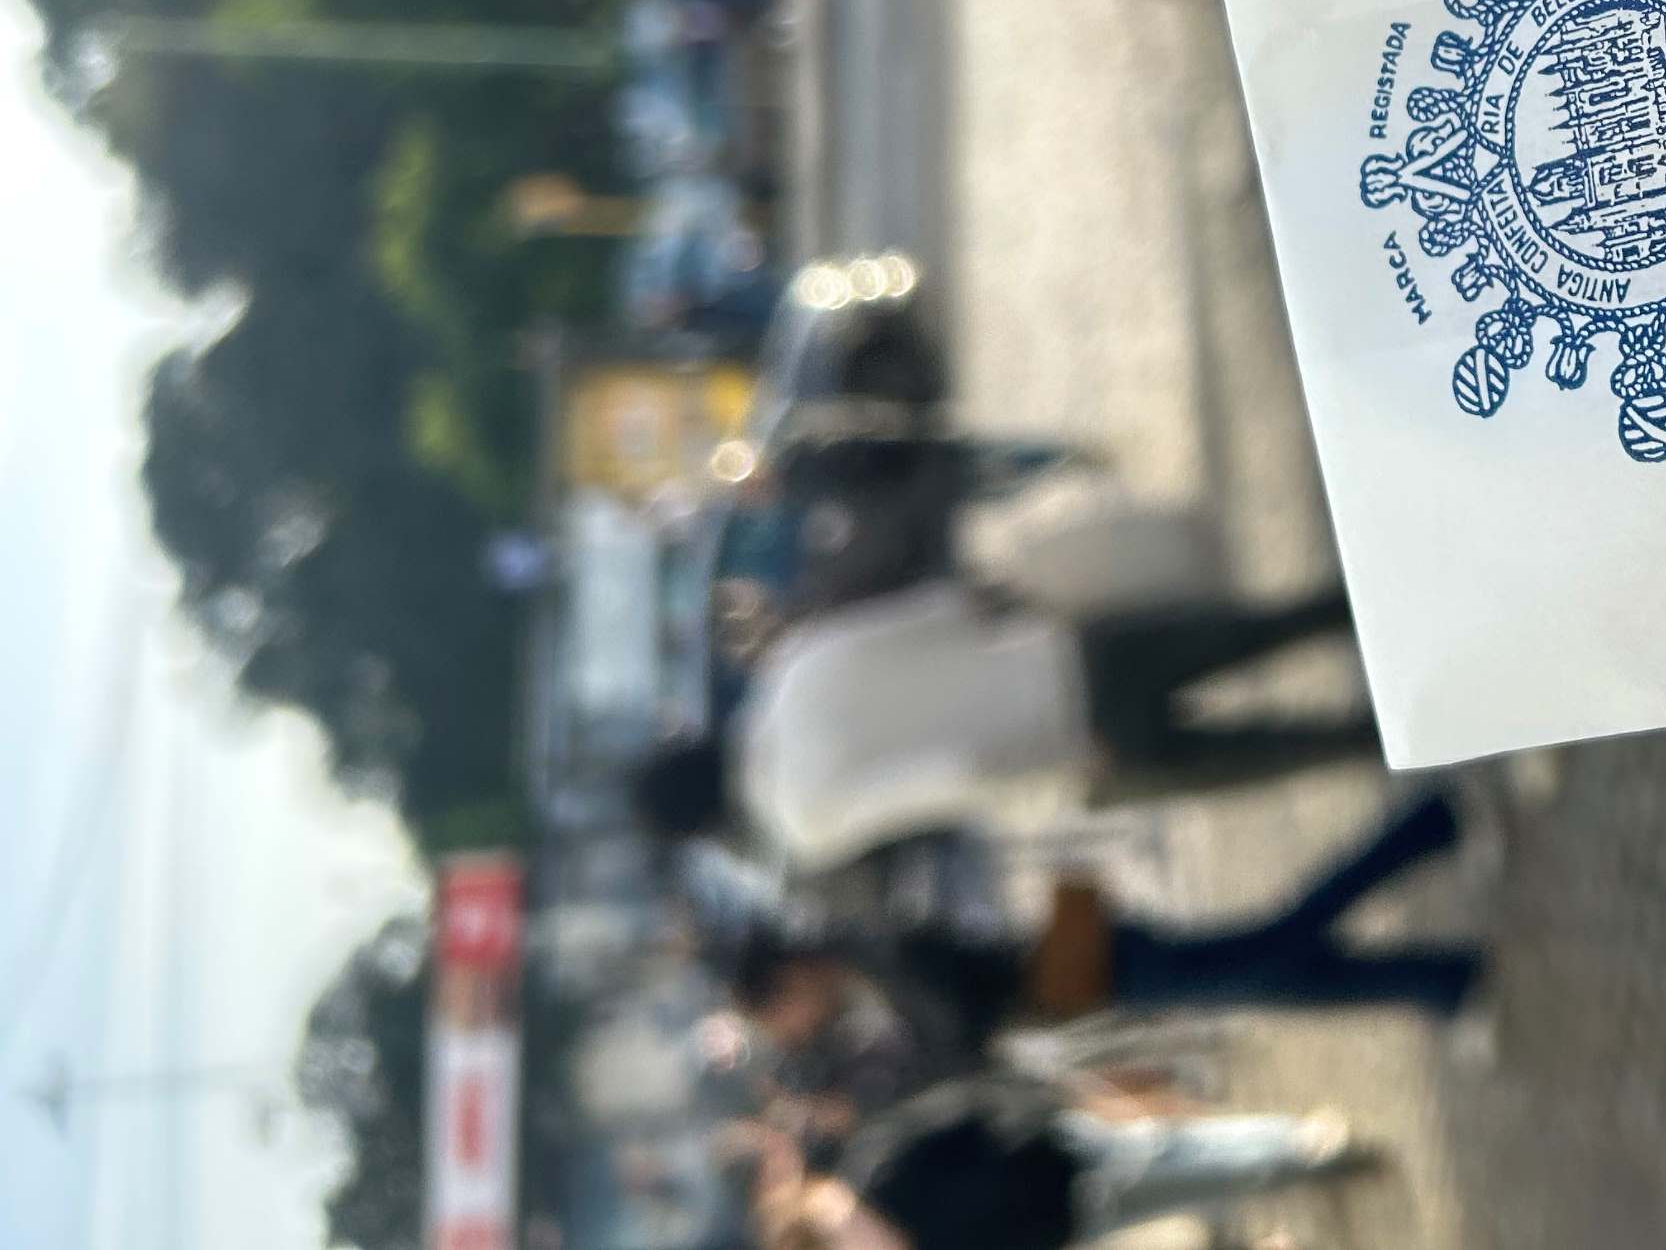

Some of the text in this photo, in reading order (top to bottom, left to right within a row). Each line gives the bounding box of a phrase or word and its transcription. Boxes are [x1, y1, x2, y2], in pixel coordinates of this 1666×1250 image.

[1499, 45, 1525, 76] DE
[1370, 21, 1432, 325] MARCA REGISTADA
[1556, 264, 1631, 305] ANTIGA
